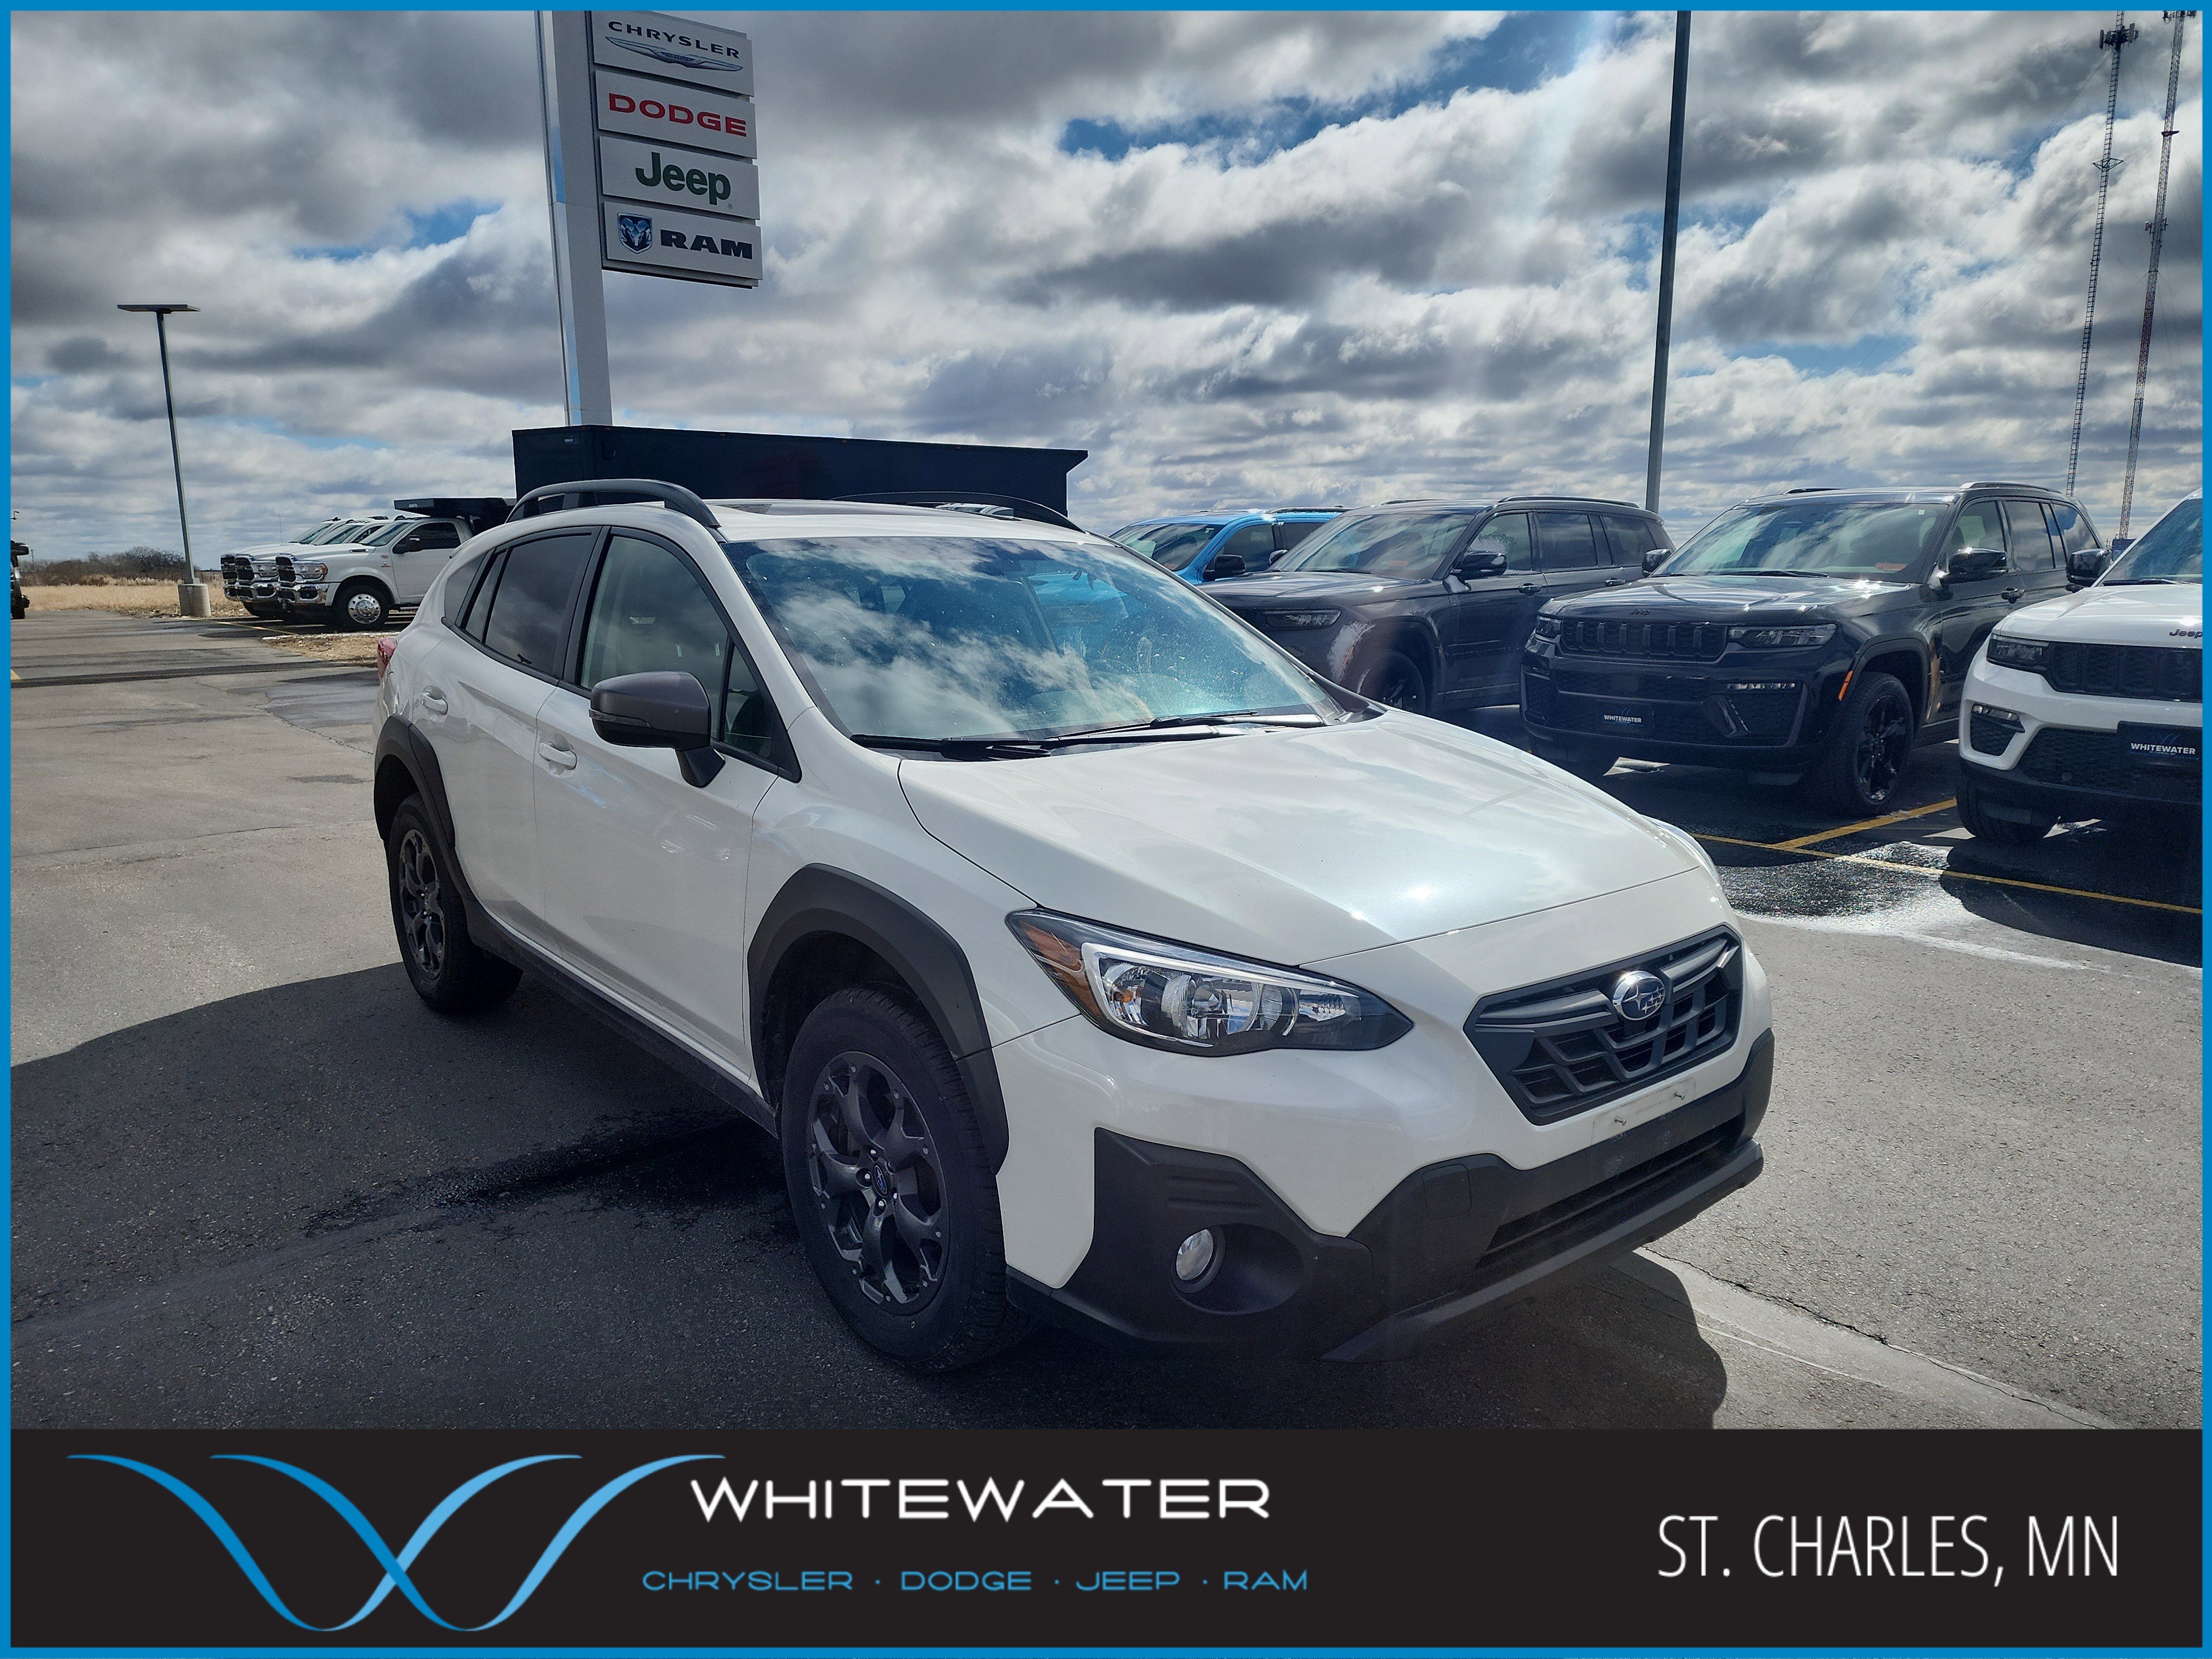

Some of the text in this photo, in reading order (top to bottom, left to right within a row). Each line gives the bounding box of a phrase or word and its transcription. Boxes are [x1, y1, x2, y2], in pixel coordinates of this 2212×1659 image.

[608, 21, 739, 59] CHRYSLER
[609, 93, 747, 137] DODGE
[635, 152, 731, 205] Jeep
[660, 229, 752, 259] RAM
[1604, 714, 1641, 723] WHITEWATER
[2131, 743, 2195, 754] WHITEWATER
